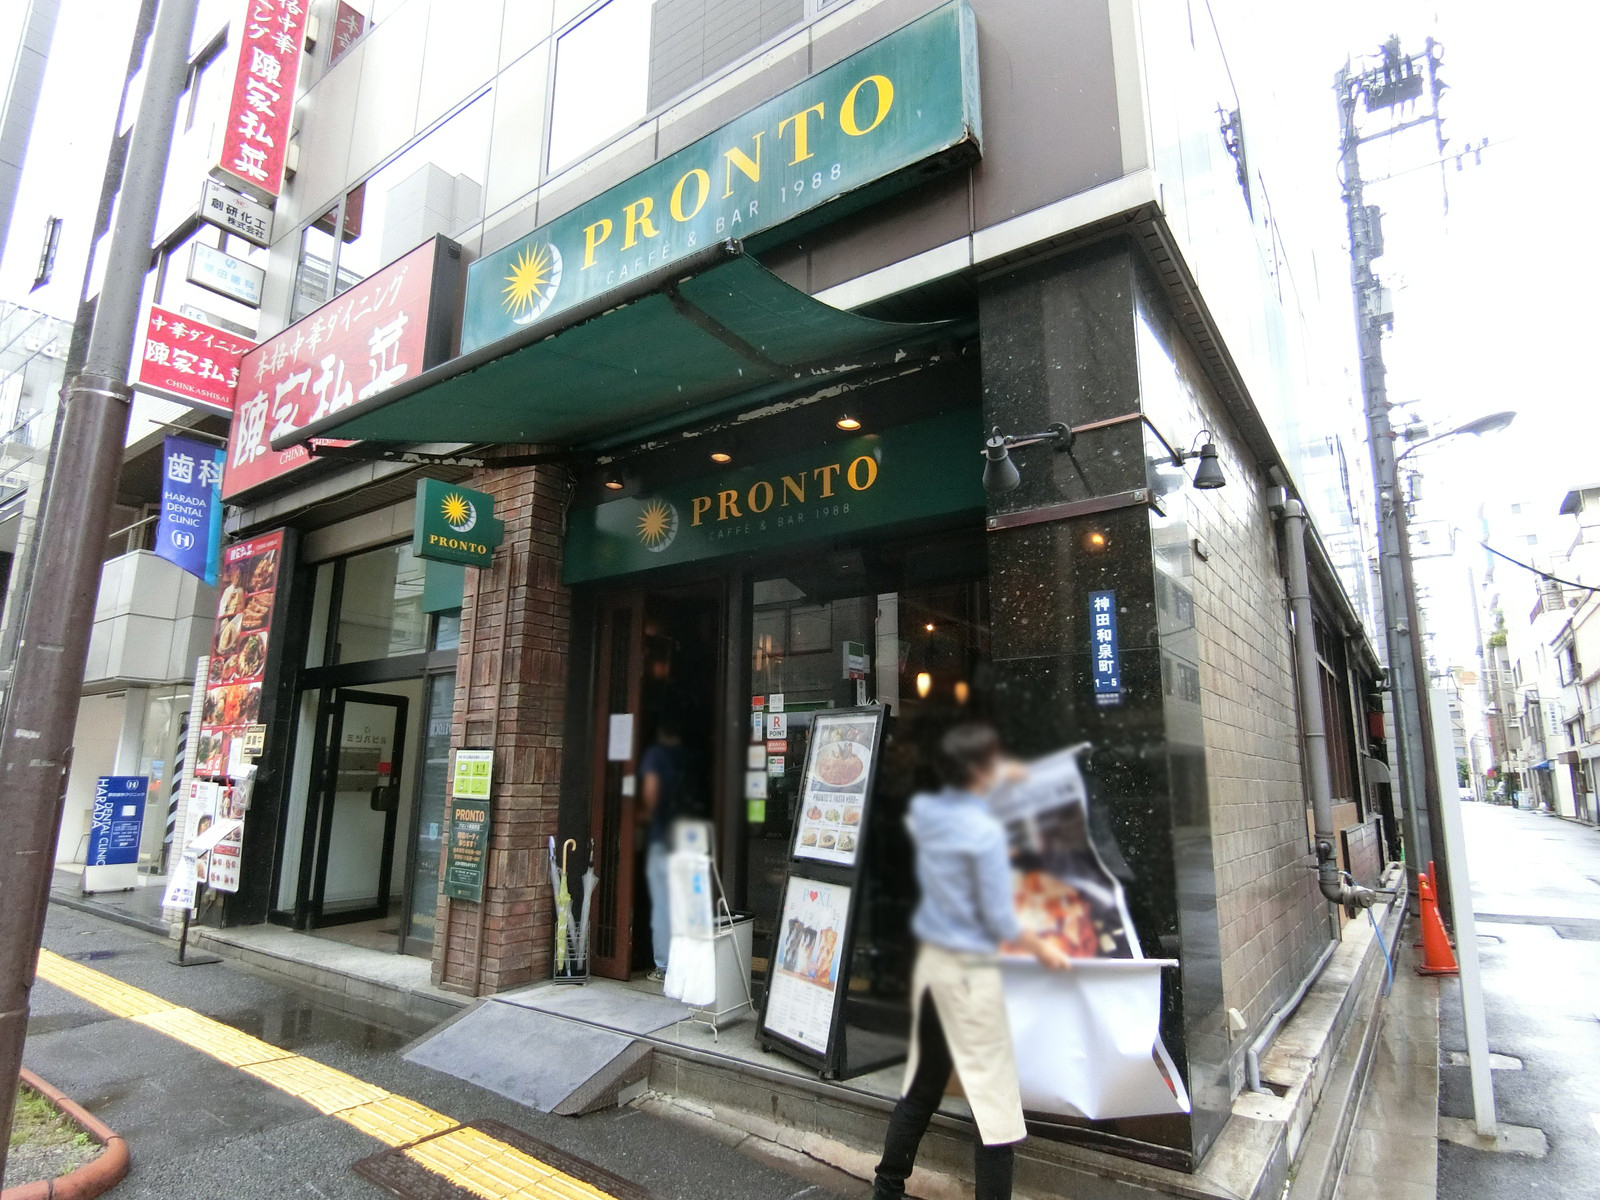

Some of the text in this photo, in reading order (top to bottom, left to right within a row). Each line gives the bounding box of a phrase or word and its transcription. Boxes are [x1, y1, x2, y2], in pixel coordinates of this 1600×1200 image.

[234, 46, 283, 181] 陳家私菜
[580, 74, 895, 271] PRONTO
[211, 198, 266, 231] 創研化工
[687, 231, 697, 247] &
[715, 200, 759, 234] BAR
[780, 164, 841, 203] 1988
[227, 216, 265, 239] 株式会社
[151, 314, 250, 355] 中華ダイニン
[254, 265, 409, 385] 本格中華ダイニング
[167, 453, 225, 490] 歯科
[164, 490, 208, 508] HARADA
[690, 455, 879, 527] PRONTO
[166, 502, 204, 518] DENTAL
[168, 513, 201, 528] CLINIC
[760, 520, 767, 531] &
[777, 512, 804, 528] BAR
[815, 502, 850, 519] 1988
[429, 534, 487, 555] PRONTO
[1094, 596, 1115, 674] 神田和泉町
[773, 715, 781, 728] R
[91, 778, 110, 829] HARADA
[99, 802, 114, 836] DENTAL
[455, 808, 486, 823] PRONTO
